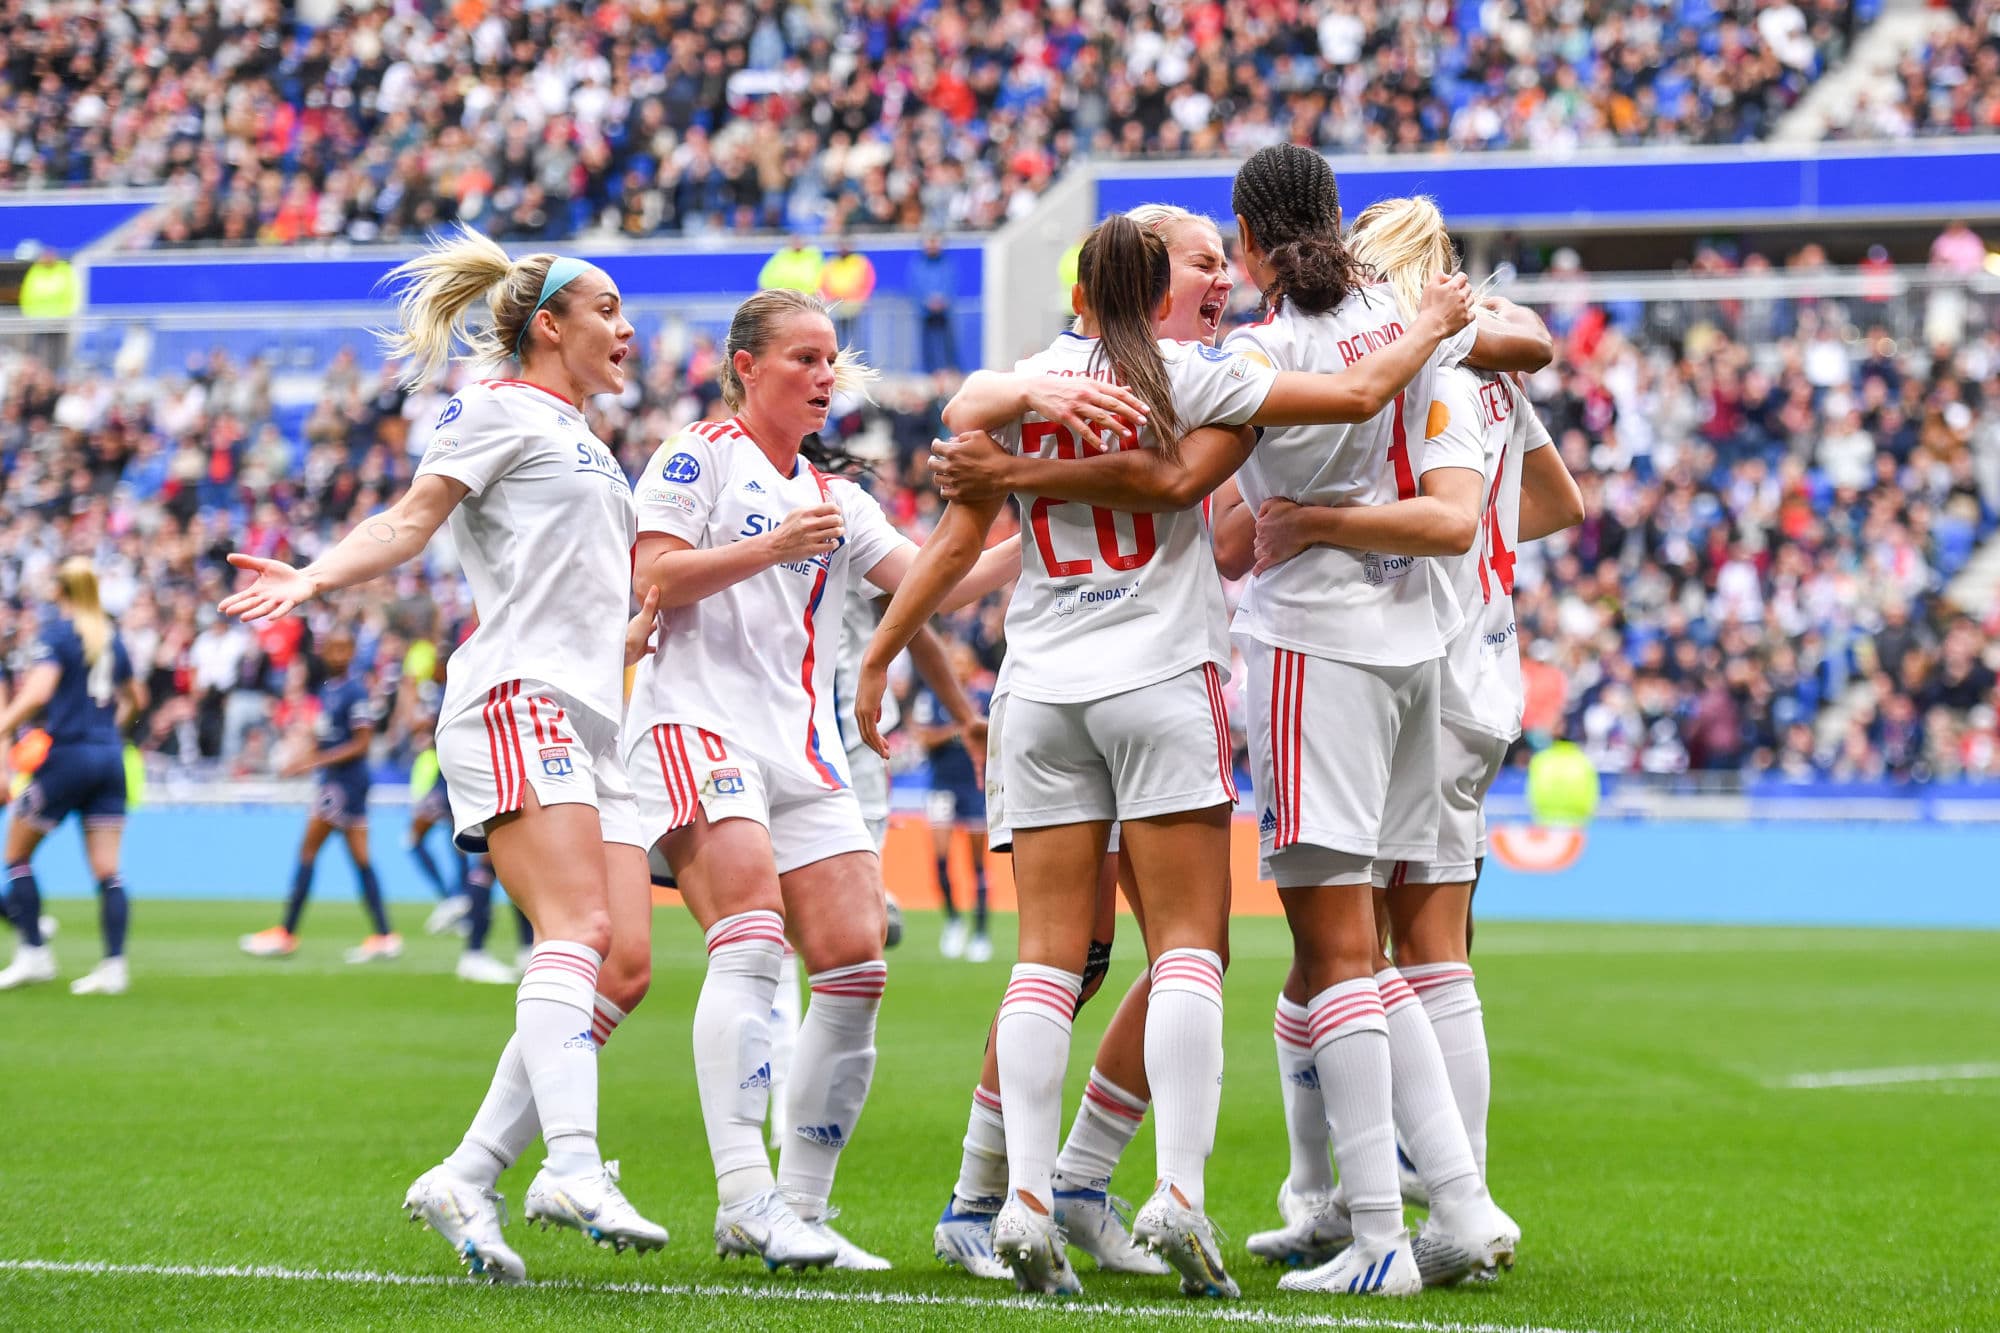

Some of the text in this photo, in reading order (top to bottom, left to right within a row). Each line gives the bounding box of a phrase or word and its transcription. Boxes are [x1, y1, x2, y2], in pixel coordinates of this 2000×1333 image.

[1022, 413, 1157, 578] 20
[527, 696, 573, 745] 12
[545, 759, 573, 774] OL
[717, 778, 744, 793] OL
[797, 1126, 845, 1149] adidas
